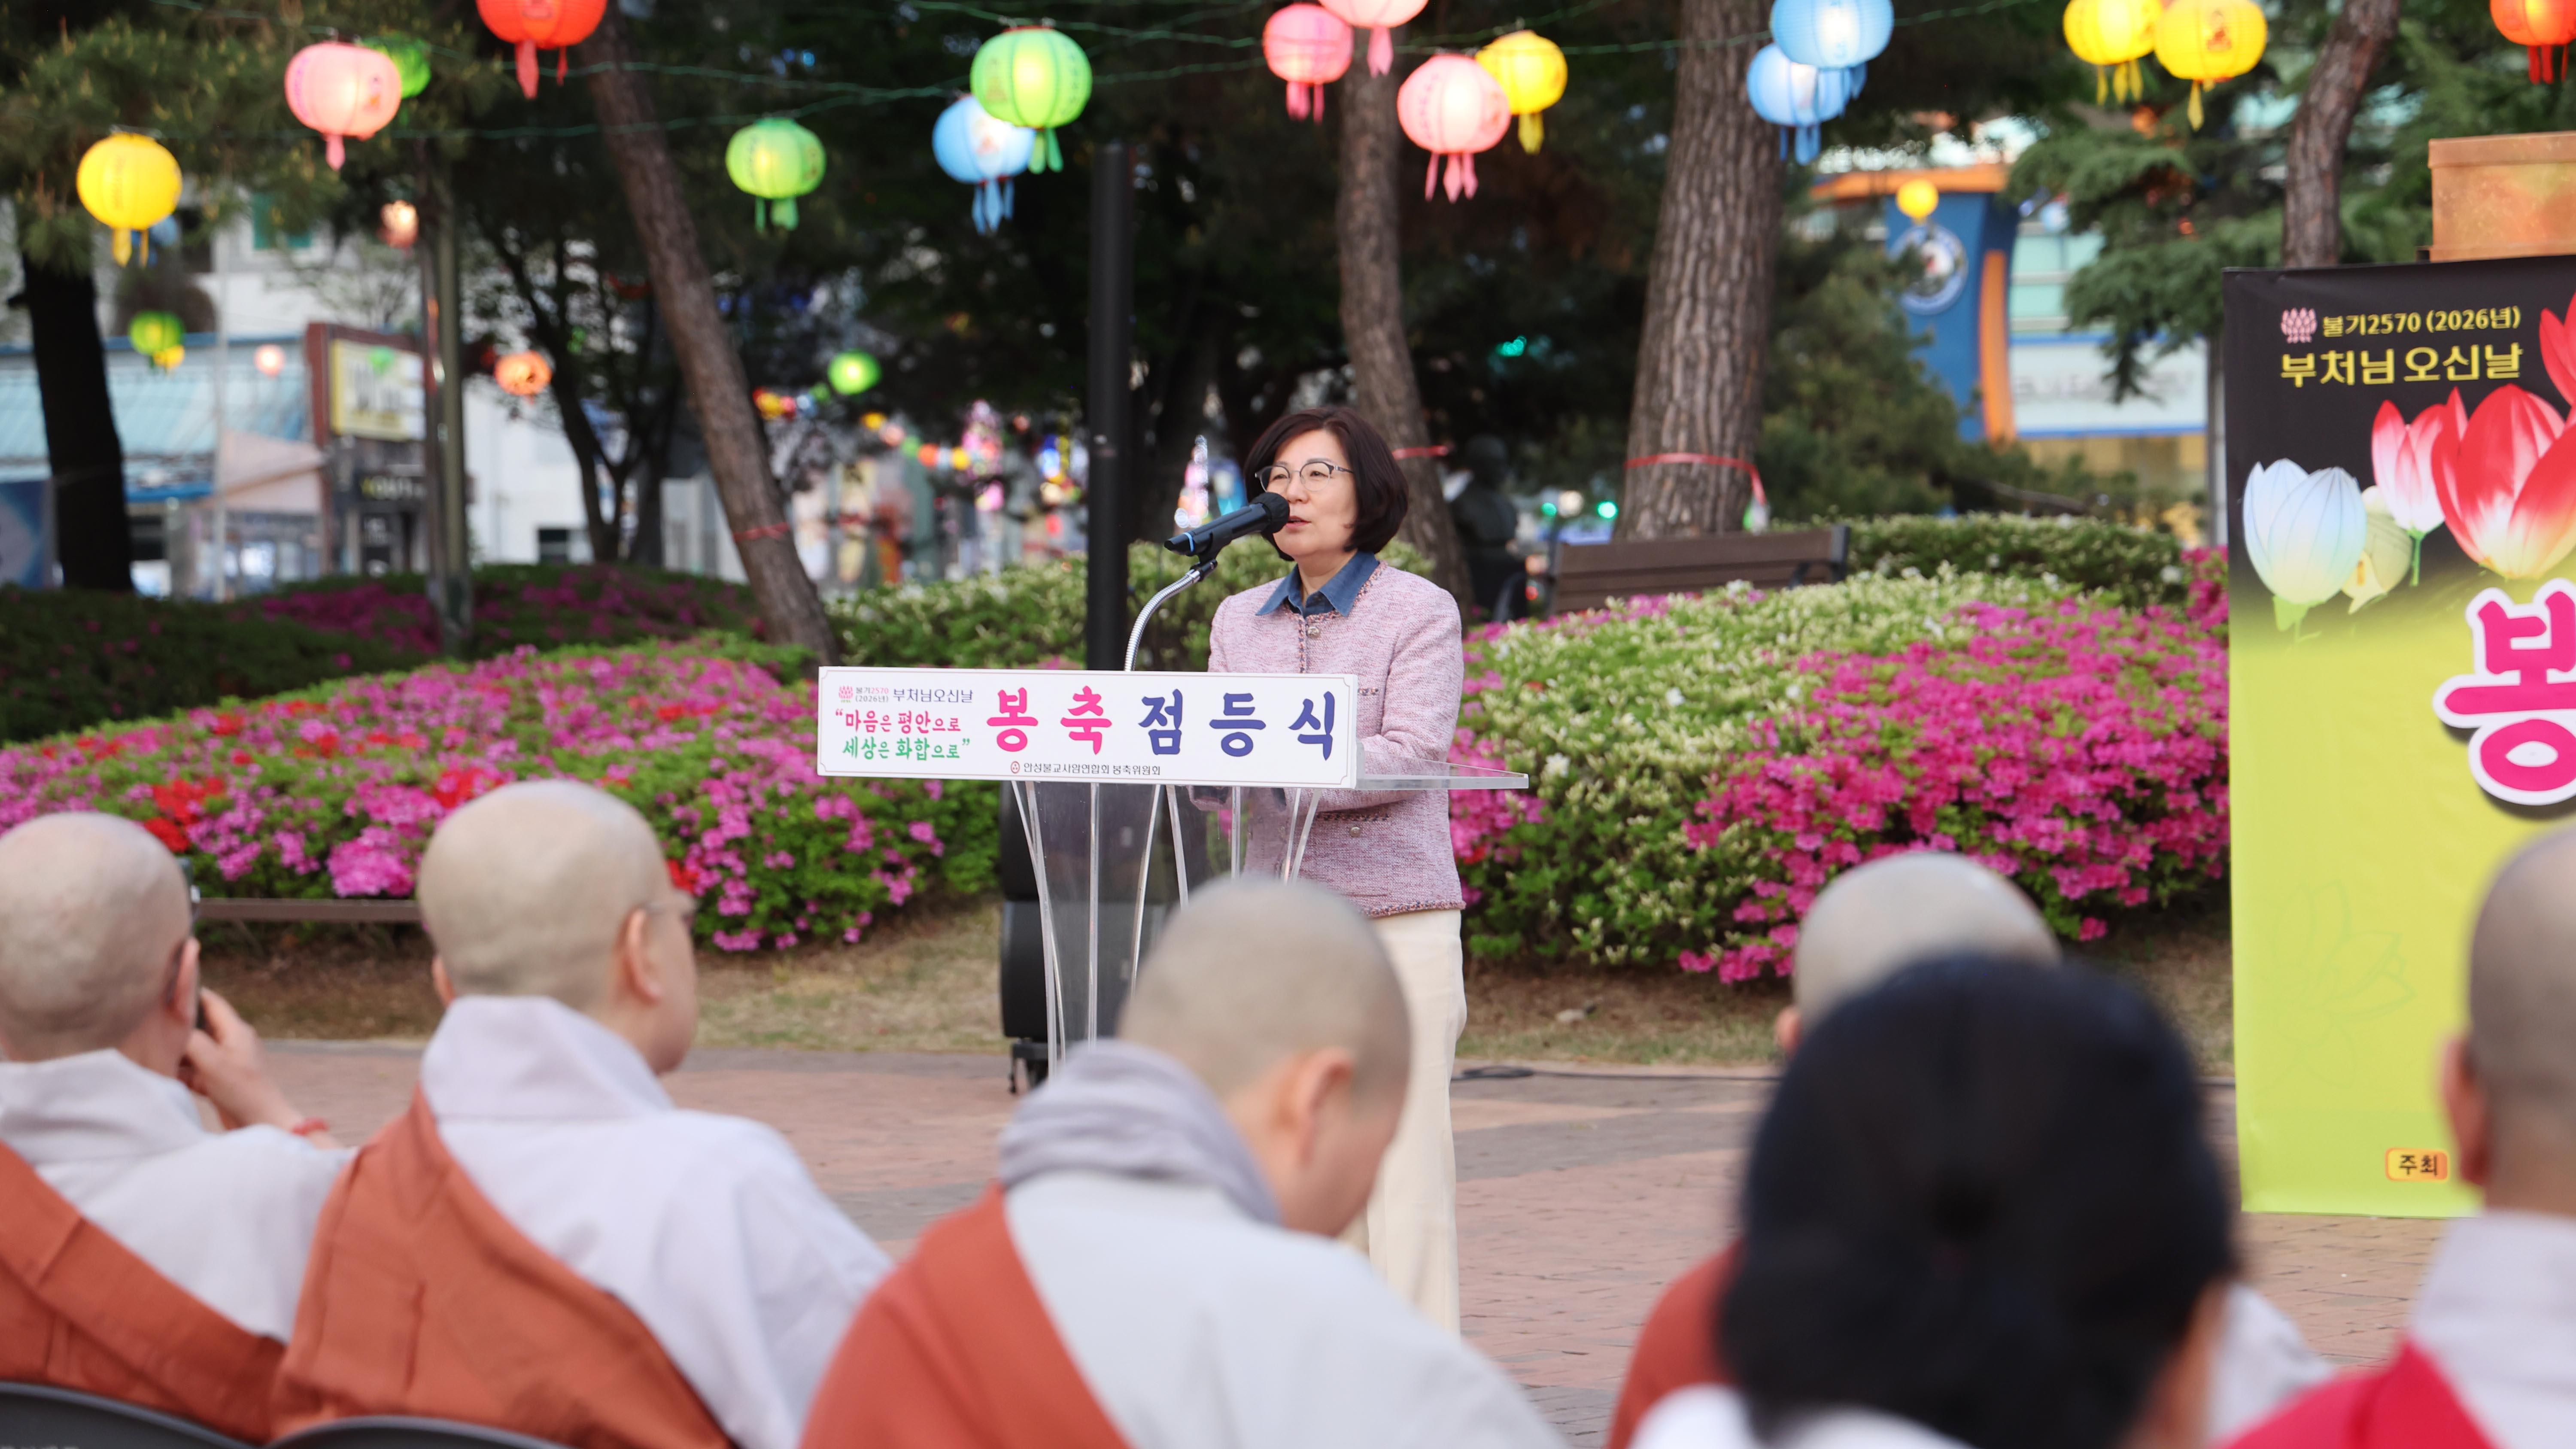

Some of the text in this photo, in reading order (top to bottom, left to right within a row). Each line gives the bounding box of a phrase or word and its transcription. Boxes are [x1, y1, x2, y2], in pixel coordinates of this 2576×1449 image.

[2323, 305, 2521, 337] 불기2570 (2026년)
[898, 710, 961, 734] 평안으로
[842, 735, 890, 760] 세상은
[1024, 762, 1160, 775] 안성불교사암연합회 봉축위원회
[2398, 1154, 2438, 1176] 주최
